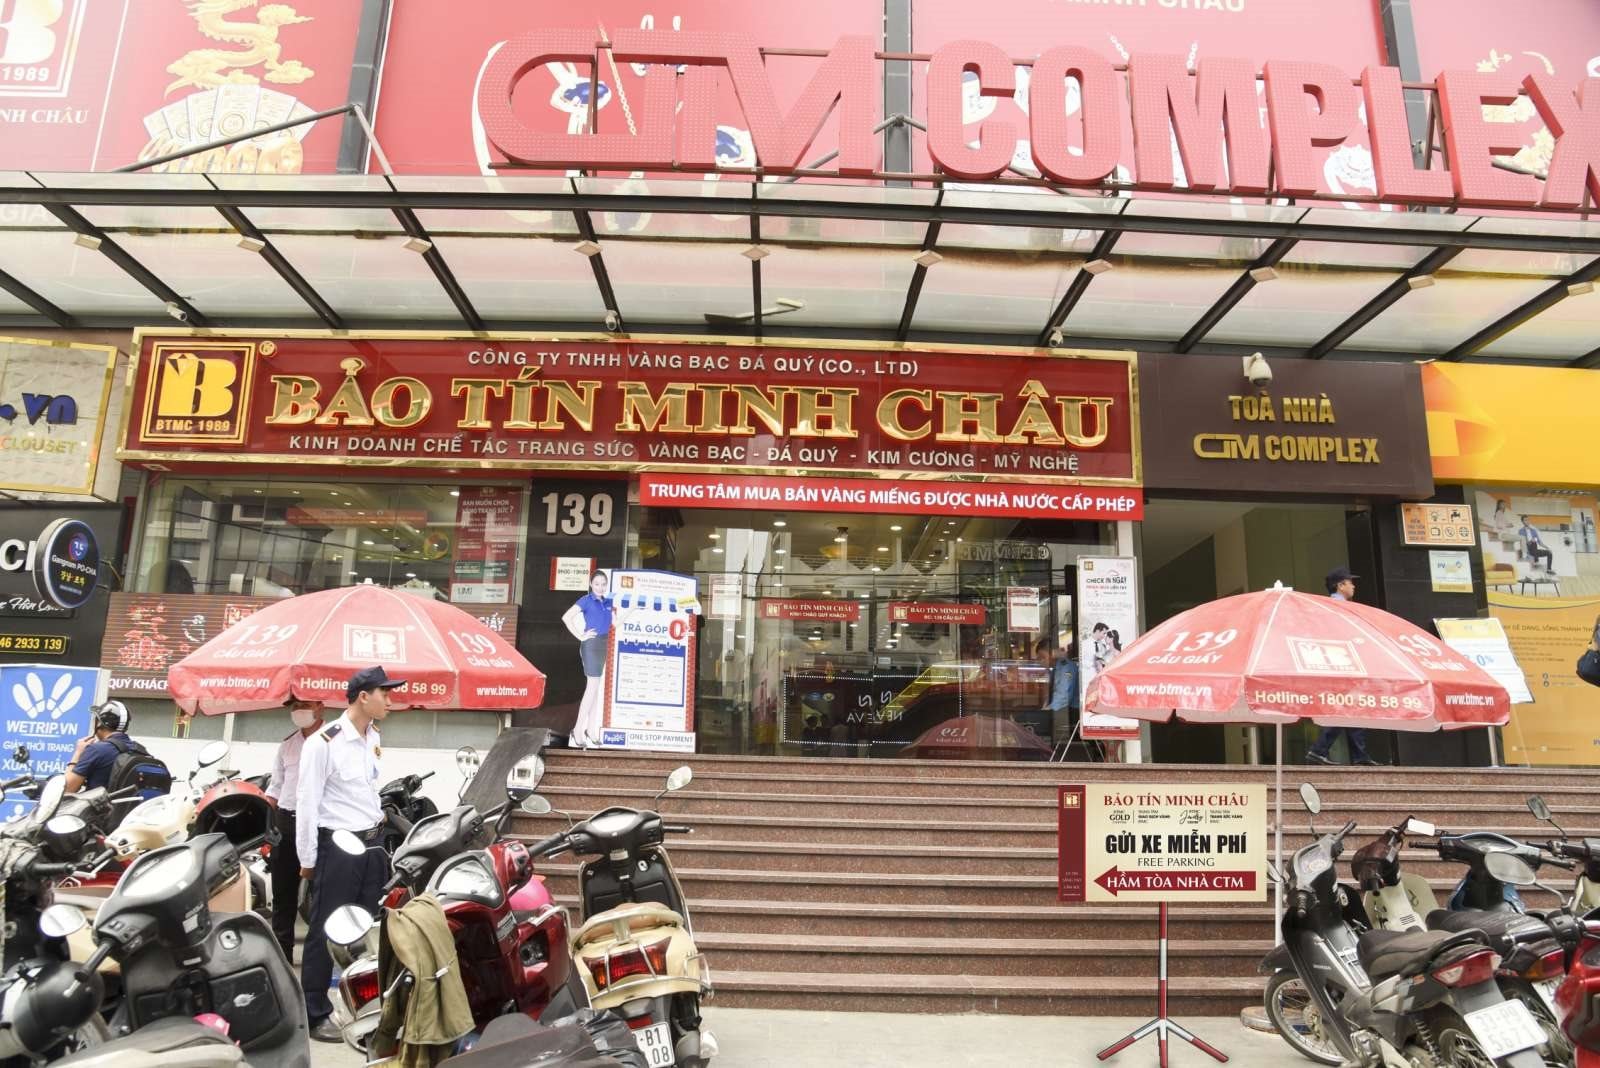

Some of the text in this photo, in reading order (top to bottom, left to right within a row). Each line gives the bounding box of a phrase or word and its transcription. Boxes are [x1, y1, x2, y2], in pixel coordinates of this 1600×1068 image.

[3, 67, 49, 81] 1989
[31, 107, 88, 124] CHÂU
[926, 40, 1600, 209] COMPLEX
[468, 347, 527, 366] CÔNG
[538, 352, 558, 366] TY
[568, 352, 621, 367] TNHH
[629, 350, 683, 369] VÀNG
[689, 355, 731, 373] BẠC
[739, 351, 766, 371] ĐÁ
[875, 361, 919, 377] LTD)
[265, 357, 1113, 447] BẢO TÍN MINH CHÂU
[1283, 393, 1335, 424] NHÀ
[156, 420, 231, 432] BTMC 1989
[289, 435, 338, 450] KINH
[348, 437, 416, 452] DOANH
[423, 433, 461, 453] CHẾ
[471, 436, 508, 454] TÁC
[518, 440, 585, 457] TRANG
[593, 437, 635, 458] SỨC
[649, 439, 699, 460] VÀNG
[708, 446, 745, 464] BẠC
[767, 441, 793, 462] ĐÁ
[799, 443, 838, 465] QUÝ
[867, 450, 900, 465] KIM
[908, 449, 975, 468] CƯƠNG
[994, 447, 1021, 468] MỸ
[1029, 453, 1079, 474] NGHỆ
[1265, 435, 1380, 464] COMPLEX
[649, 480, 1136, 513] TRUNG TÂM MUA BÁN VÀNG MIẾNG ĐƯỢC NHÀ NƯỚC CẤP PHÉP
[542, 493, 613, 536] 139
[232, 624, 299, 646] 139
[645, 621, 668, 634] GÓP
[14, 637, 40, 649] 2933
[44, 638, 63, 650] 139
[448, 631, 497, 655] 139
[1163, 629, 1238, 653] 139
[1183, 651, 1224, 664] GIẤY
[200, 676, 271, 689] www.btmc.vn
[411, 682, 427, 694] 58
[431, 683, 447, 695] 99
[1126, 682, 1211, 697] www.btmc.vn
[476, 685, 528, 697] www.btmc.vn
[1445, 692, 1494, 706] www.btmc.vn
[1255, 689, 1422, 710] Hotline: 1800 58 58 99
[6, 720, 78, 735] WETRIP.VN
[629, 733, 643, 741] ONE
[646, 734, 661, 742] STOP
[663, 735, 693, 743] PAYMENT
[47, 743, 75, 752] TRANG
[1104, 792, 1249, 807] BẢO TÍN MINH CHÂU
[1105, 829, 1247, 854] GỬI XE MIỄN PHÍ
[1138, 857, 1215, 867] FREE PARKING
[1107, 871, 1244, 888] HẦM TÒA NHÀ CTM
